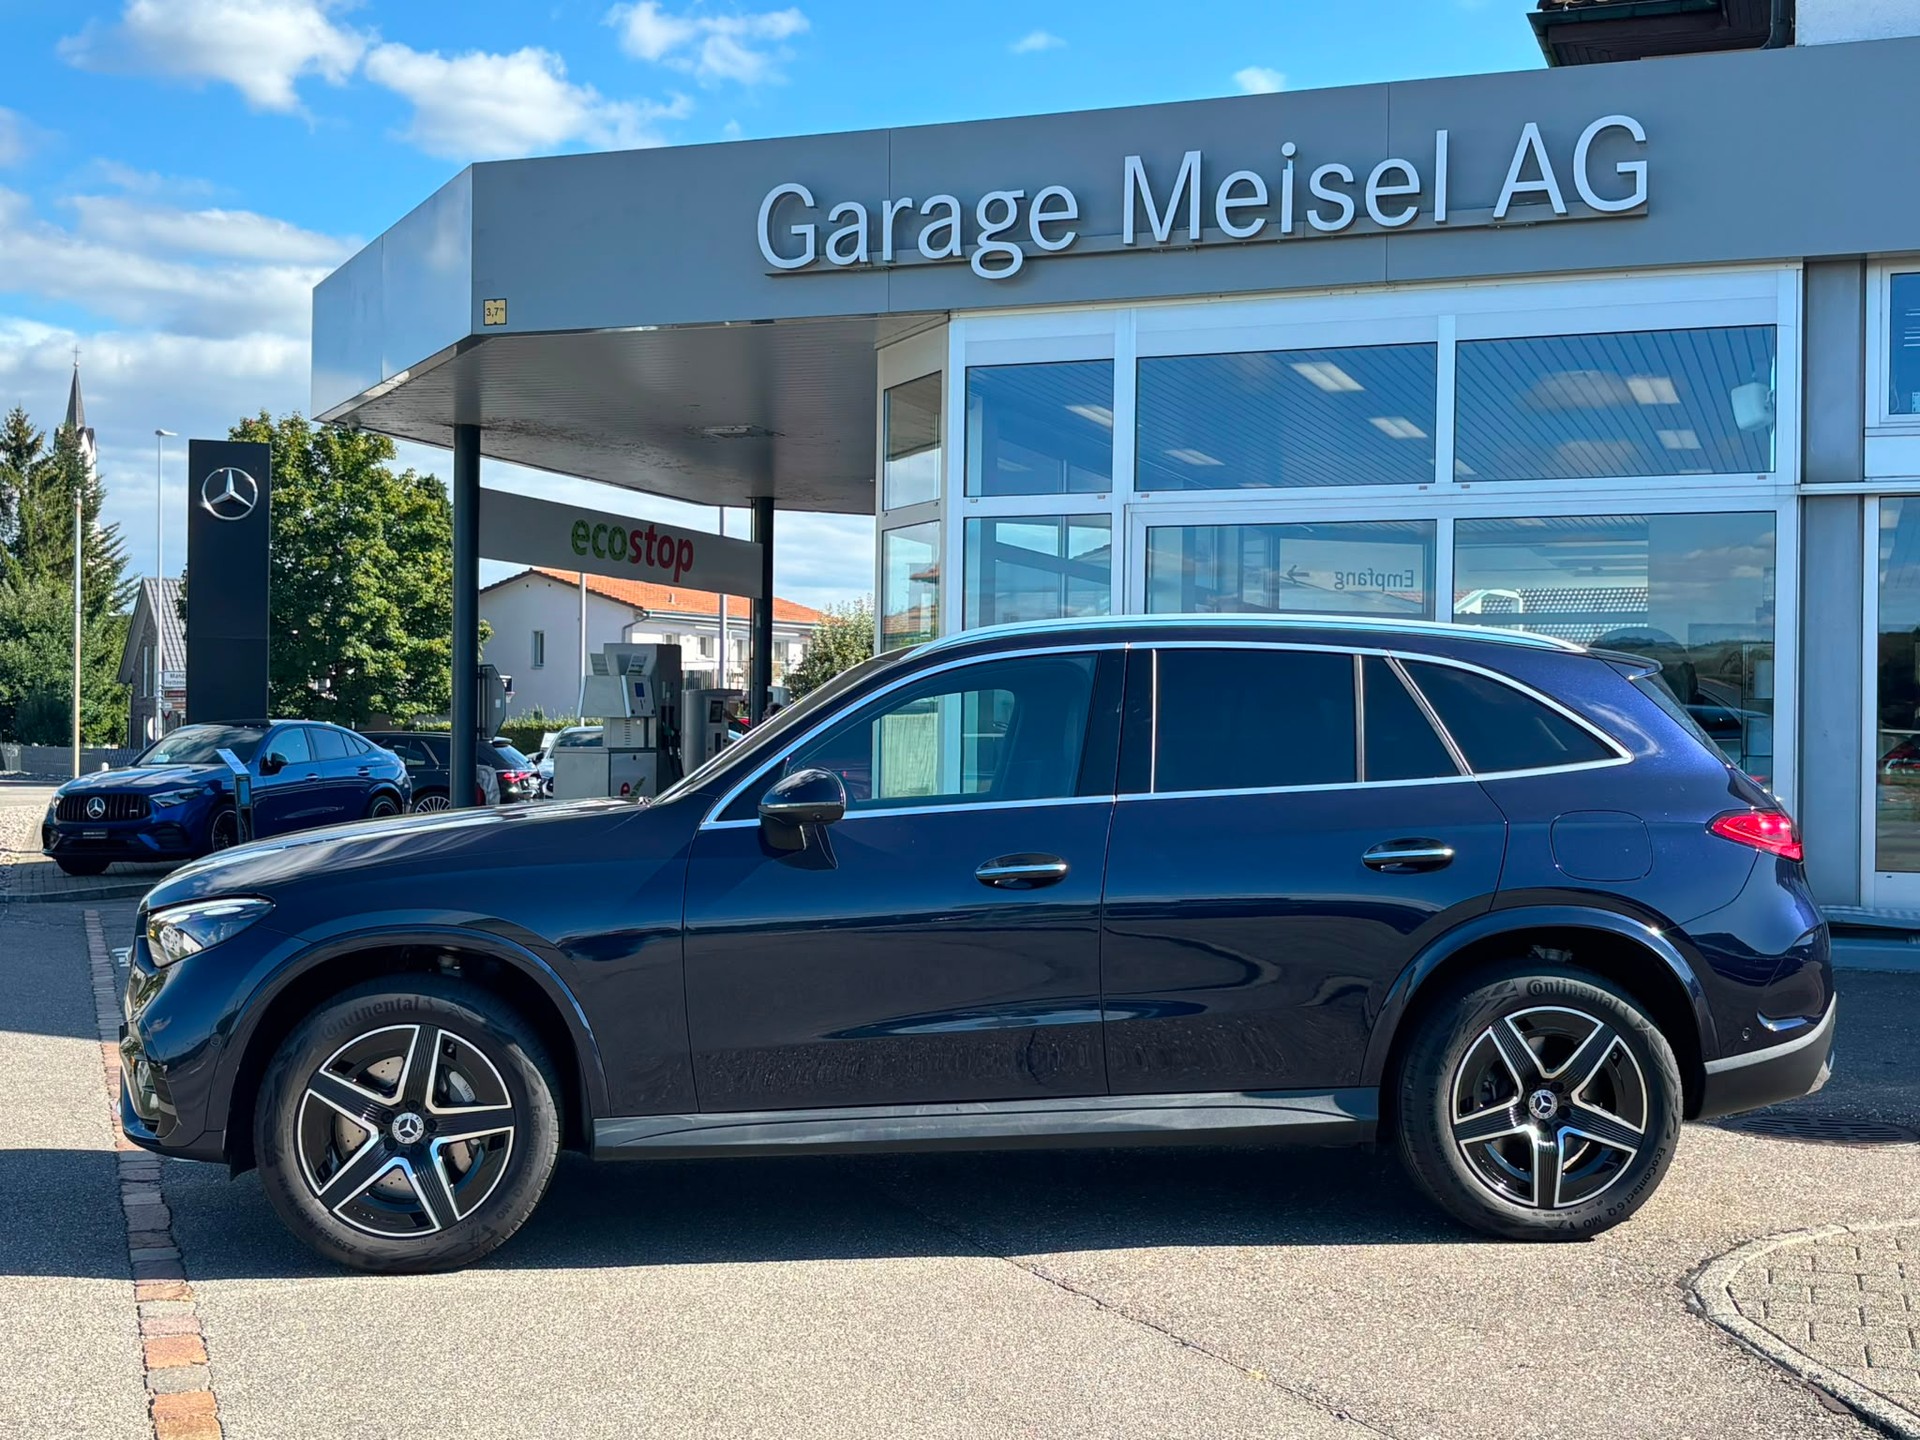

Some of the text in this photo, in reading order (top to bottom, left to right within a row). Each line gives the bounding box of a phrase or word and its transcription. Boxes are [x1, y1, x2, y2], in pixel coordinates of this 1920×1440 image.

[757, 114, 1648, 279] Garage Meisel AG
[571, 519, 694, 583] ecostop
[1527, 980, 1620, 1010] Continental
